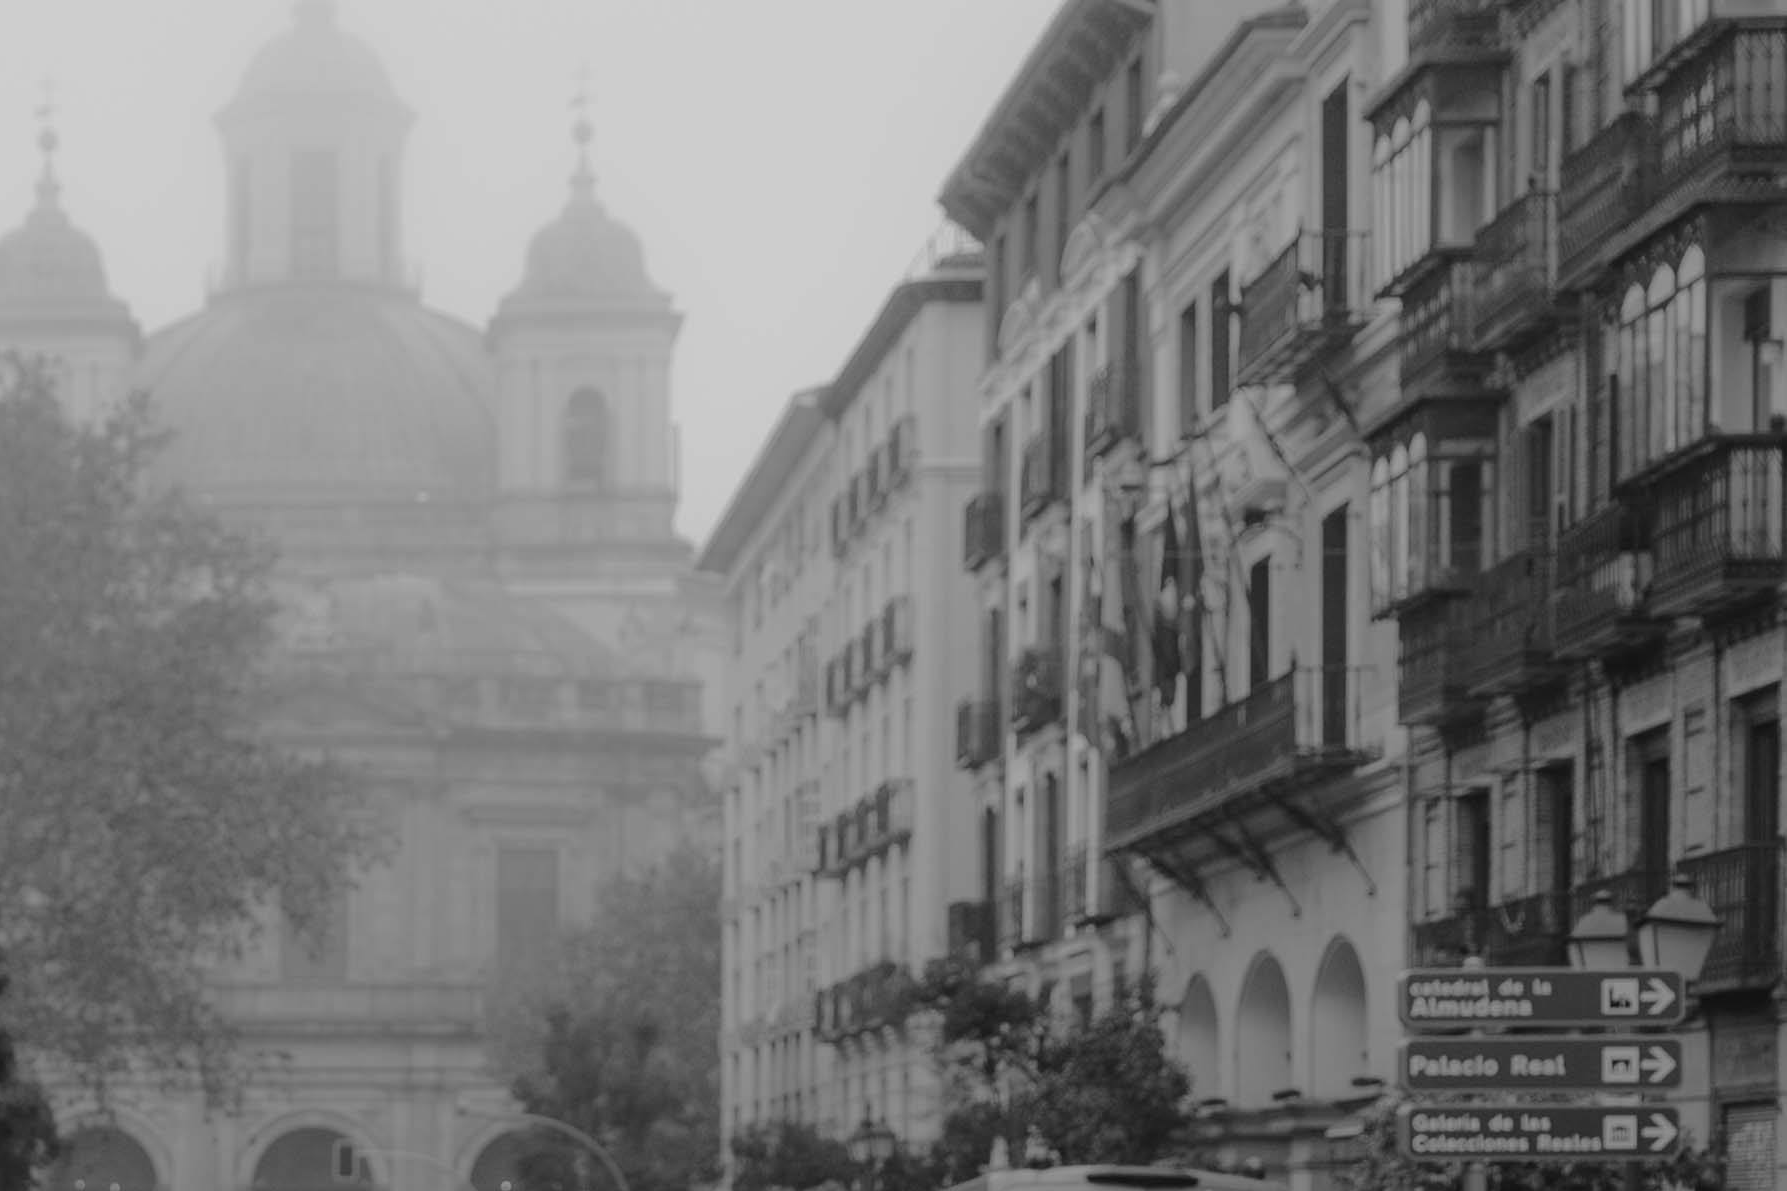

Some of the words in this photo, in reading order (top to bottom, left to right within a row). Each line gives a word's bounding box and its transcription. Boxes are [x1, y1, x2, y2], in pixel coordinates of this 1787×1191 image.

[1498, 977, 1524, 997] de
[1532, 977, 1552, 996] la
[1409, 996, 1533, 1017] Almudena
[1409, 1054, 1499, 1076] Palacio
[1509, 1054, 1567, 1076] Real
[1488, 1112, 1514, 1132] de
[1520, 1112, 1552, 1132] las
[1411, 1133, 1530, 1153] Colecciones
[1536, 1133, 1602, 1153] Reales
